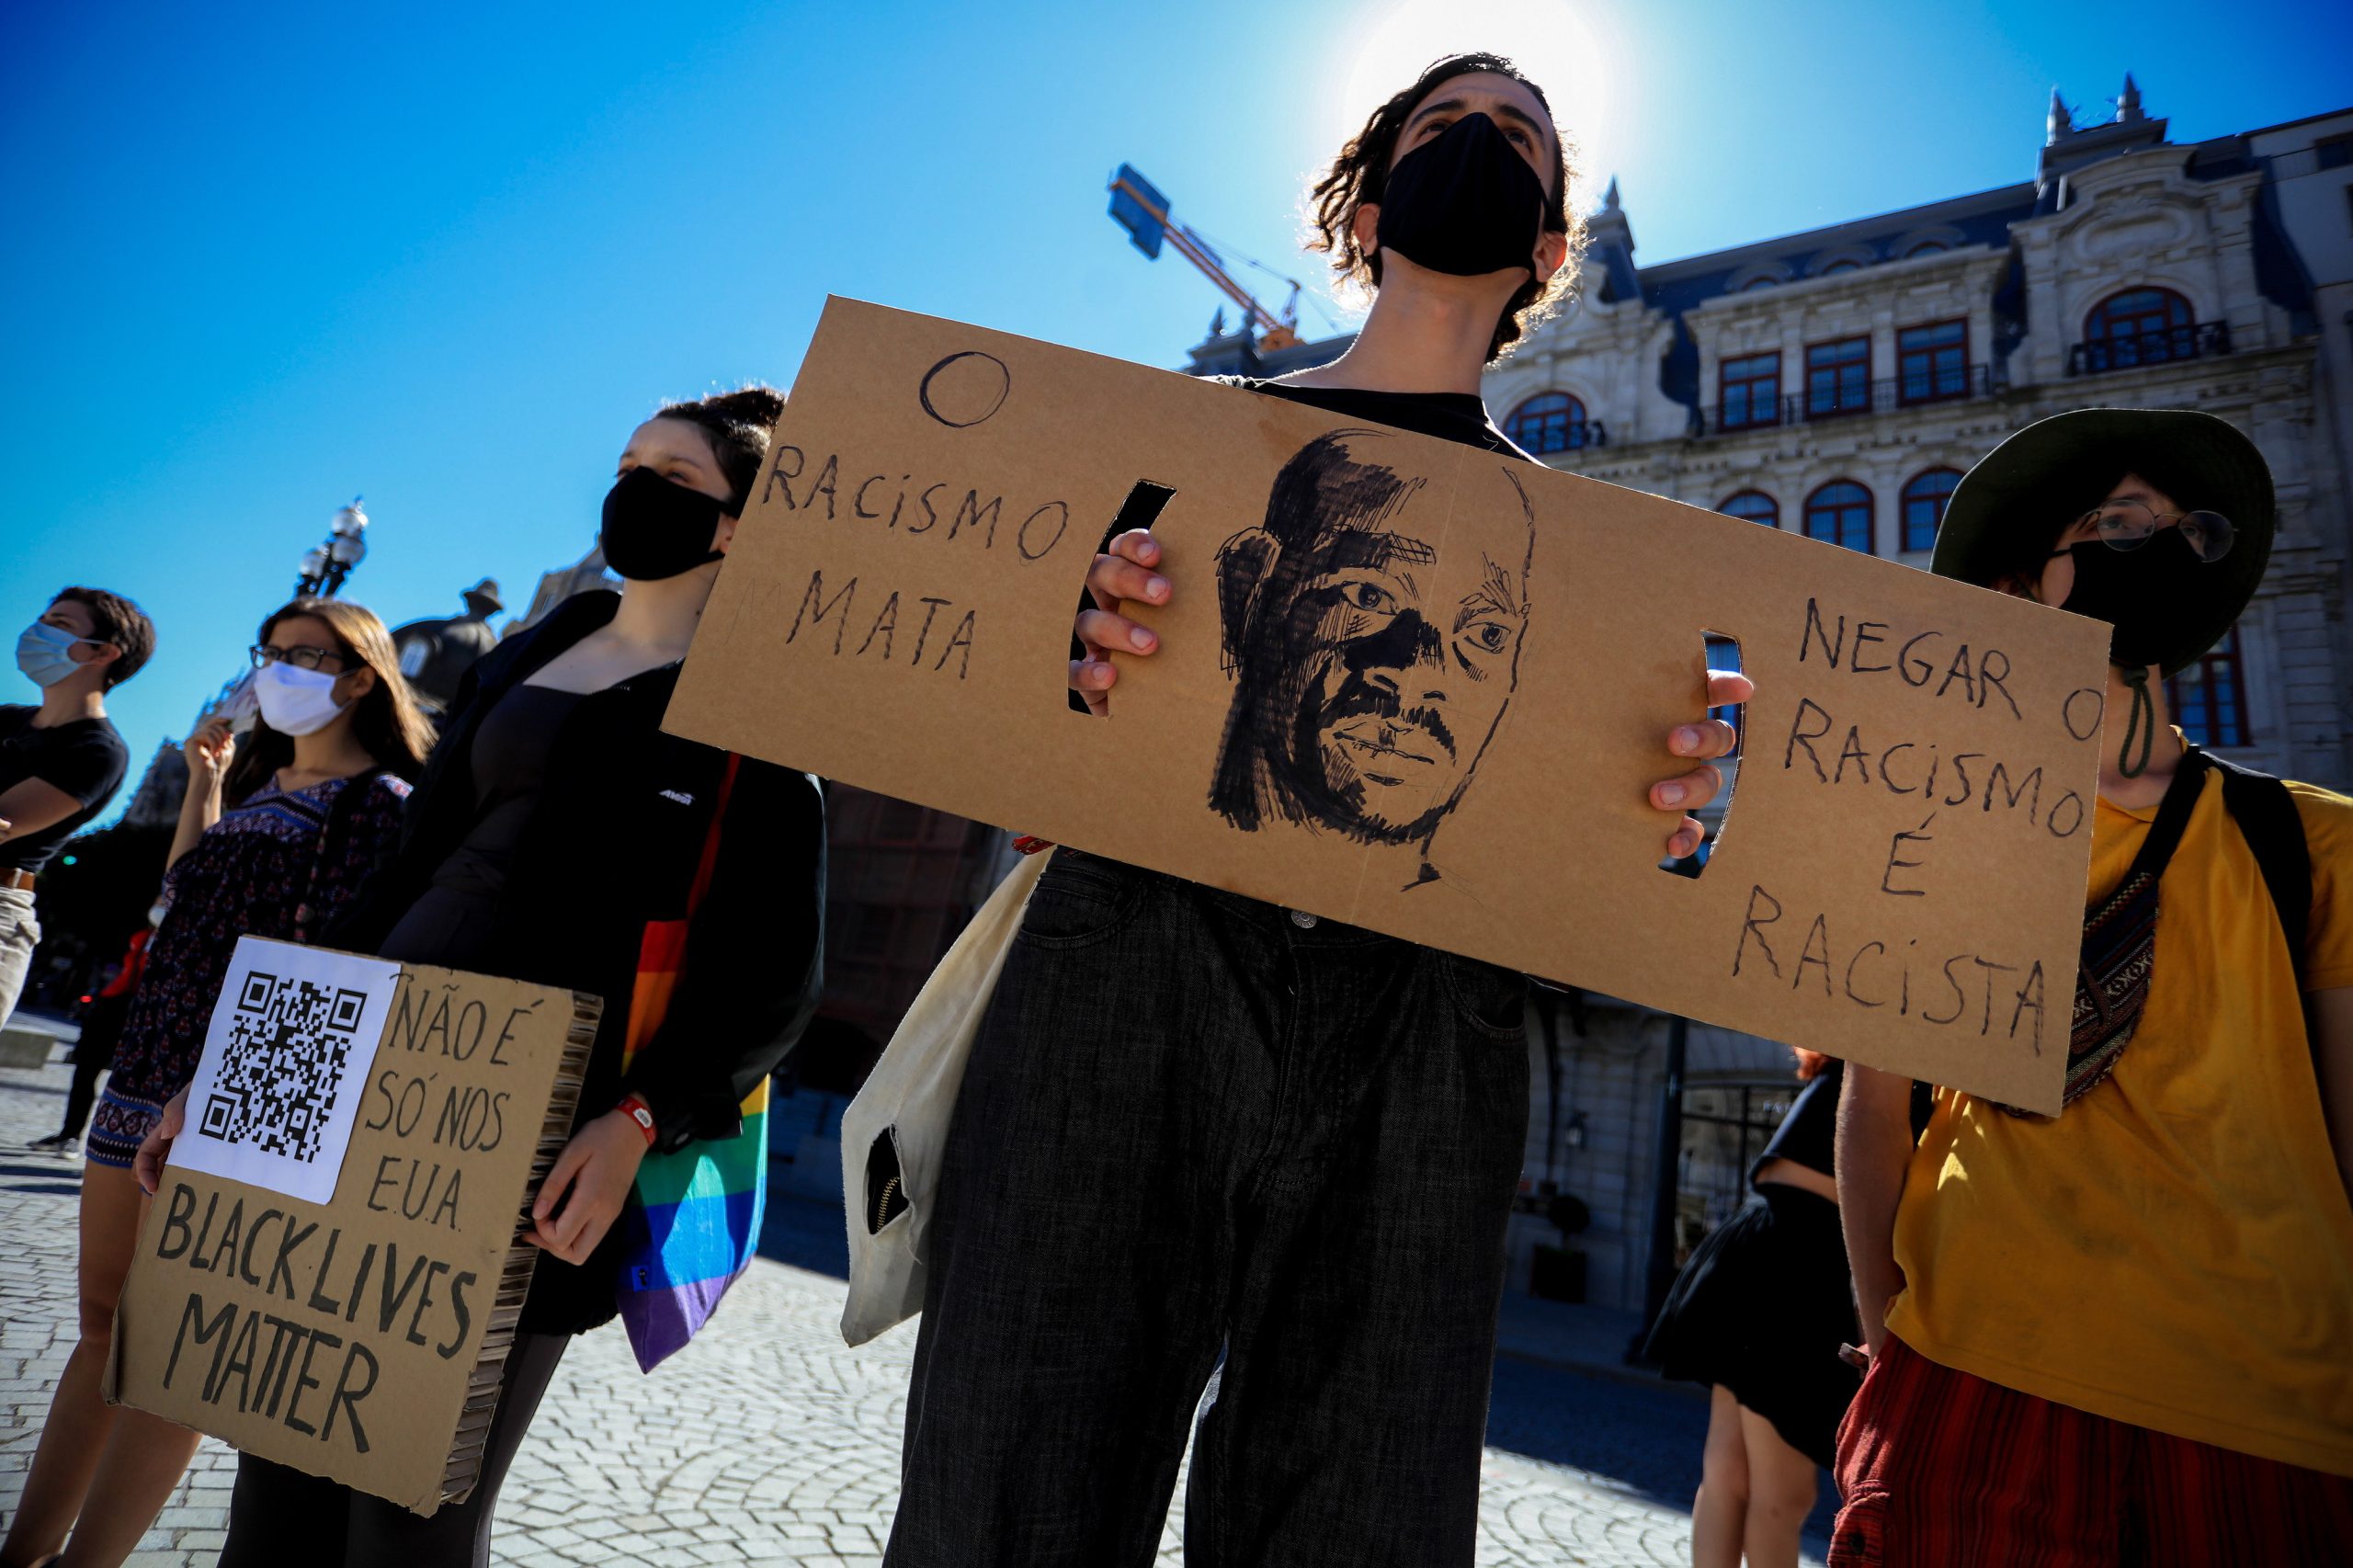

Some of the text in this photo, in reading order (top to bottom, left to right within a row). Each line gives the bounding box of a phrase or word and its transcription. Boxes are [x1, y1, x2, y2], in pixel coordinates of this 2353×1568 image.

[920, 351, 1010, 427] O
[786, 570, 975, 679] MATA
[1799, 597, 2104, 741] NEGAR O
[1881, 811, 1937, 896] É
[389, 983, 544, 1065] NÃO É
[365, 1070, 510, 1151] SÓ NOS
[156, 1183, 477, 1360] BLACK LIVES
[163, 1292, 380, 1454] MATTER
